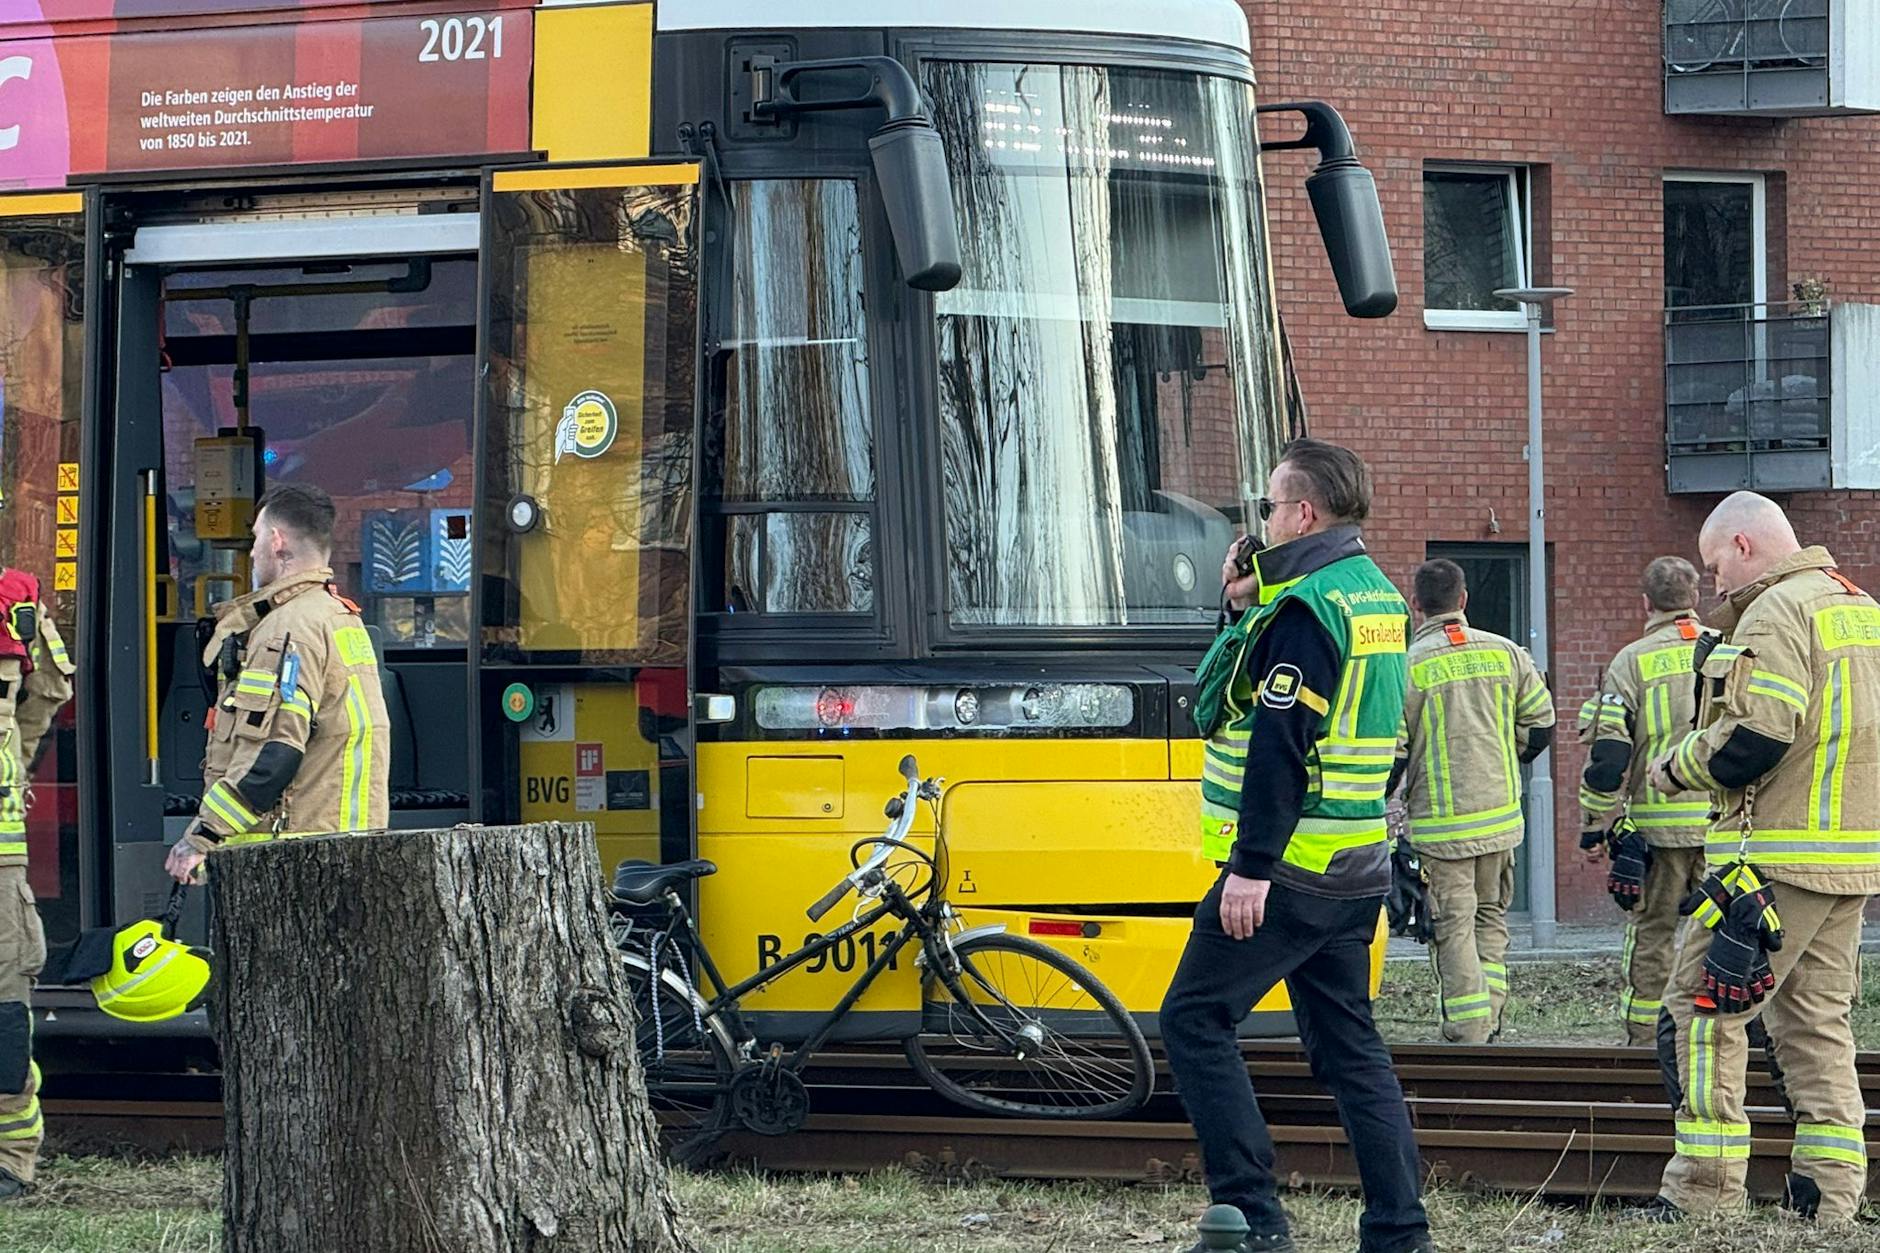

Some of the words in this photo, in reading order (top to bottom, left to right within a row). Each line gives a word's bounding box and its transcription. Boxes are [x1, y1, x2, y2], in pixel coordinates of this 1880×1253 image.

[418, 16, 503, 62] 2021
[141, 91, 162, 107] Die
[165, 89, 208, 106] Farben
[210, 87, 252, 107] zeigen
[255, 85, 280, 101] den
[283, 82, 333, 101] Anstieg
[335, 81, 358, 96] der
[140, 110, 211, 128] weltweiten
[214, 103, 374, 125] Durchschnittstemperatur
[140, 136, 163, 150] von
[166, 133, 195, 149] 1850
[198, 131, 216, 147] bis
[219, 130, 251, 147] 2021.
[1450, 661, 1505, 678] FEUERWEHR
[1274, 683, 1288, 692] BVG
[527, 776, 570, 803] BVG
